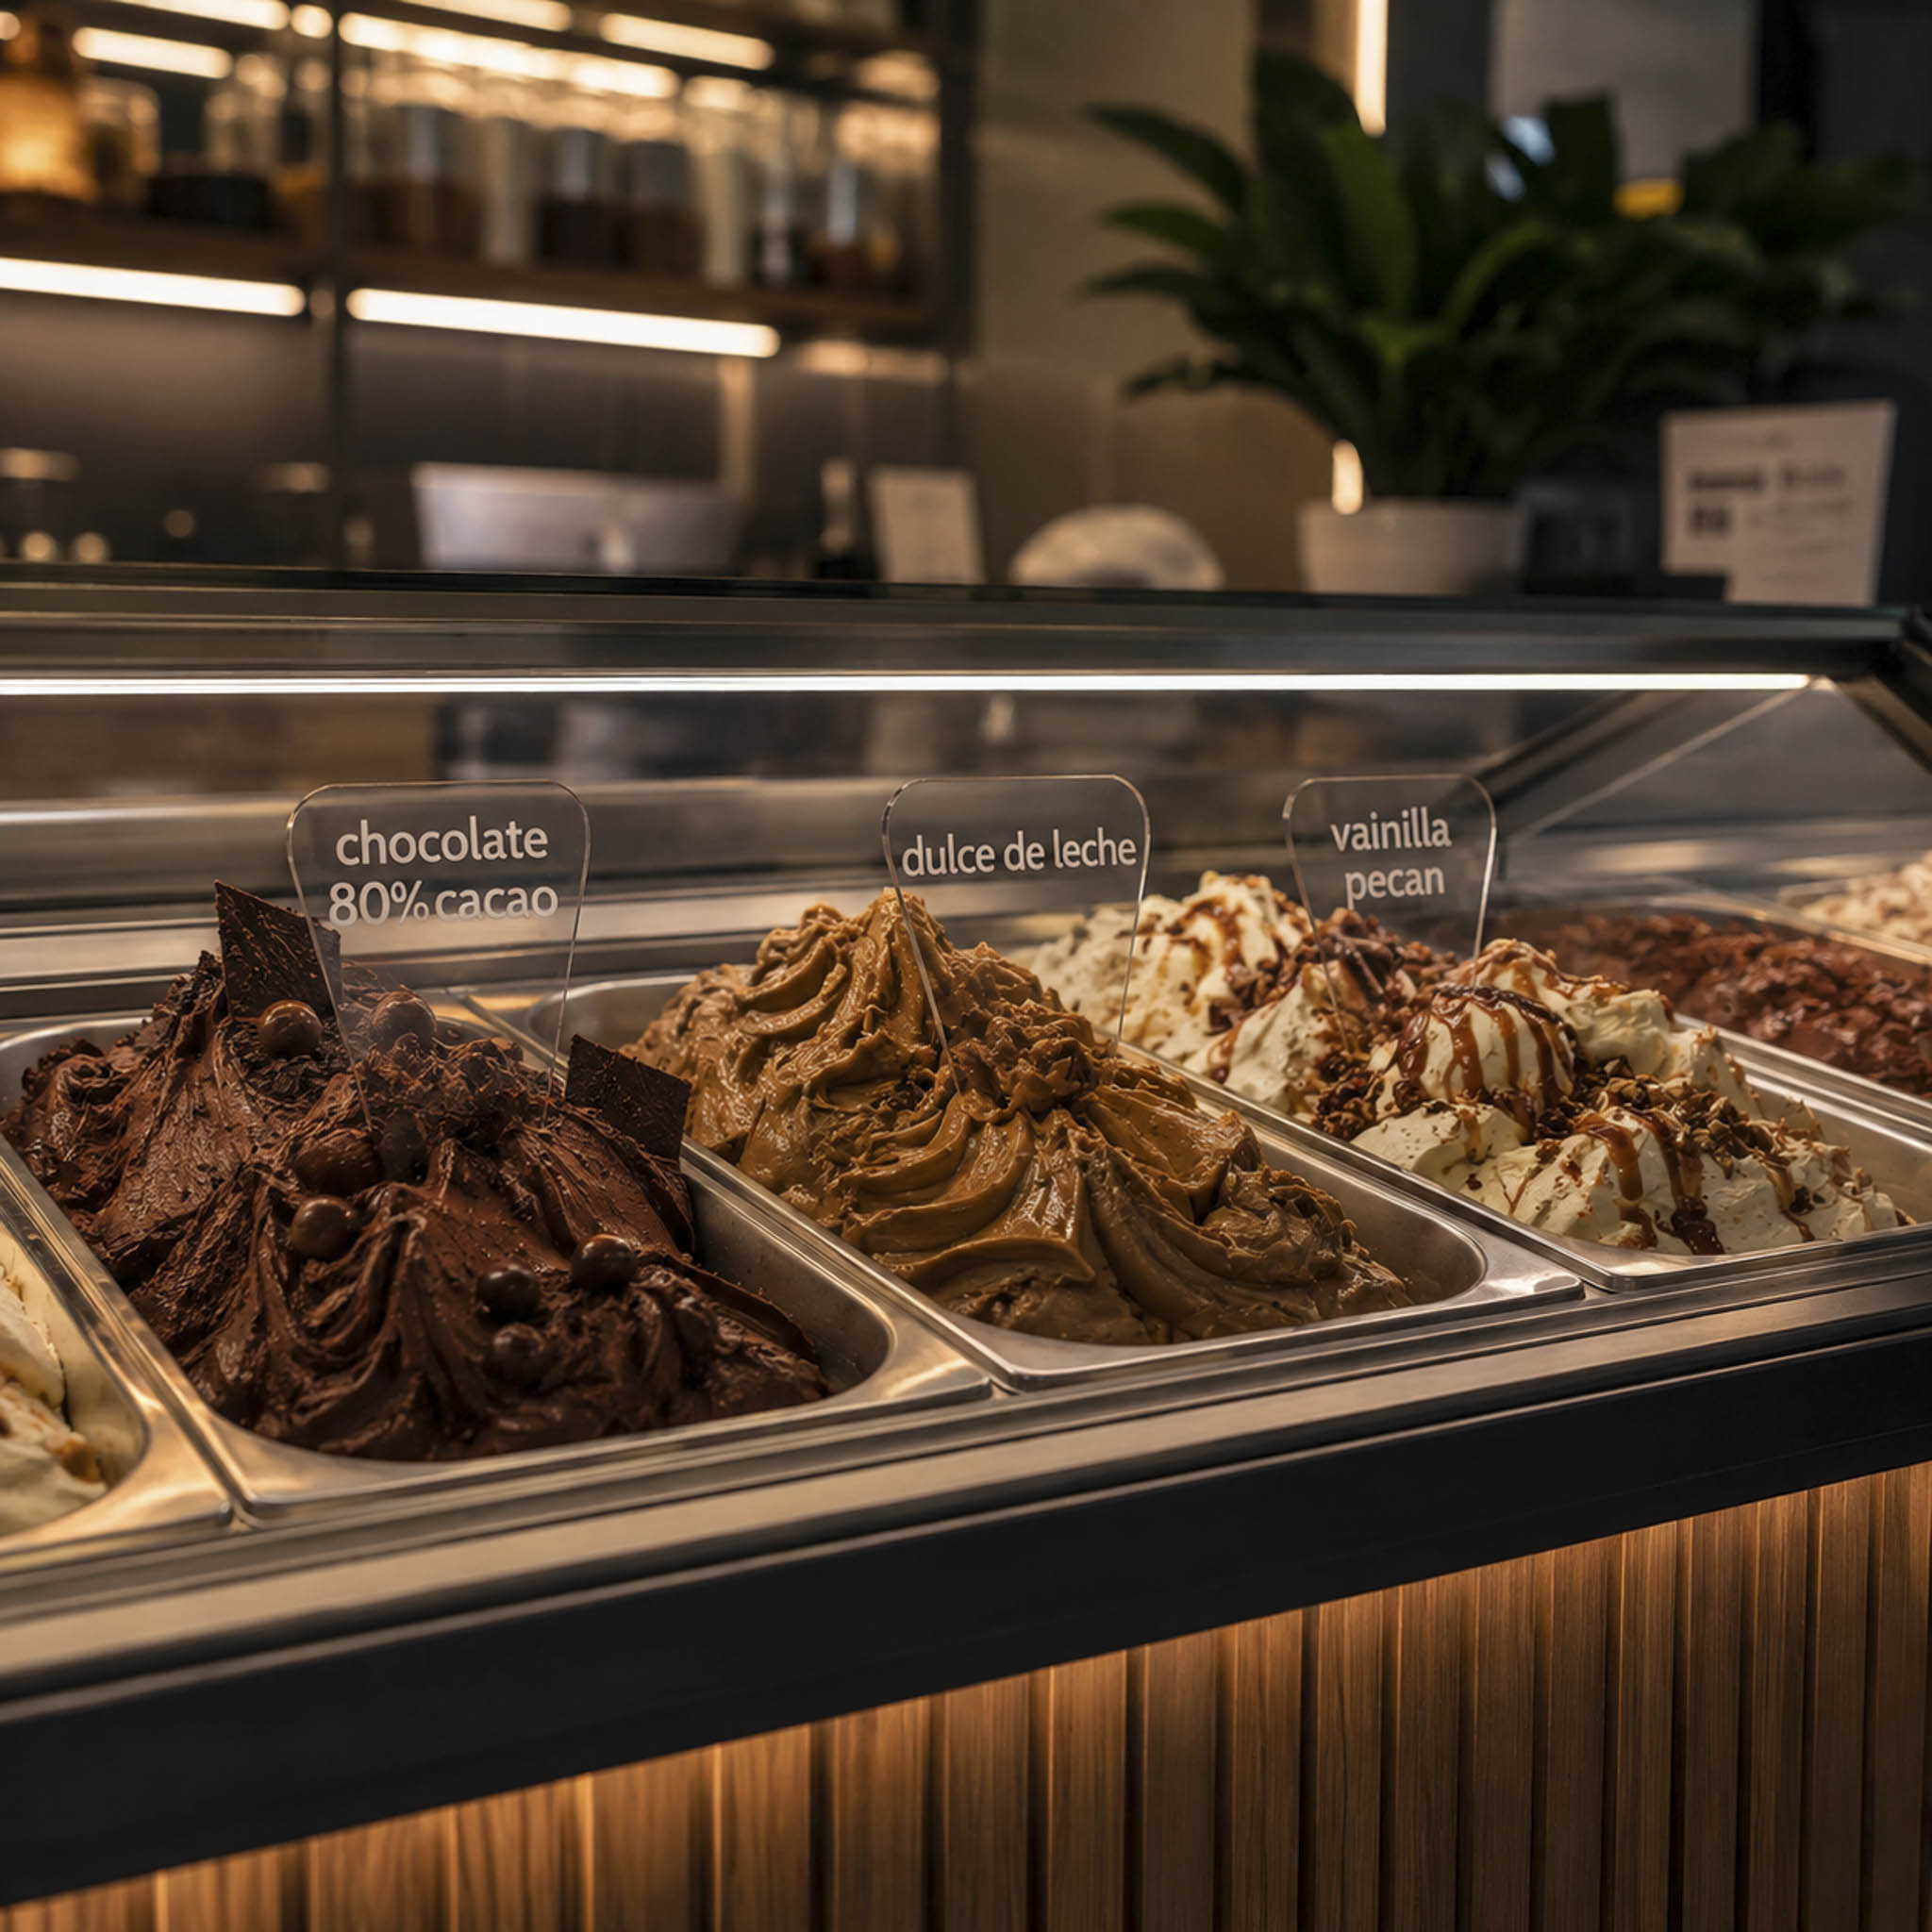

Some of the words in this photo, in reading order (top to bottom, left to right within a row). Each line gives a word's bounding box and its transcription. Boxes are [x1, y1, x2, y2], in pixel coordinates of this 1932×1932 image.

[335, 815, 549, 866] chocolate
[902, 833, 996, 877] dulce
[1003, 829, 1046, 872] de
[1053, 826, 1138, 869] leche
[1330, 807, 1453, 852] vainilla
[328, 879, 429, 927] 80%
[435, 886, 558, 922] cacao
[1344, 866, 1445, 910] pecan
